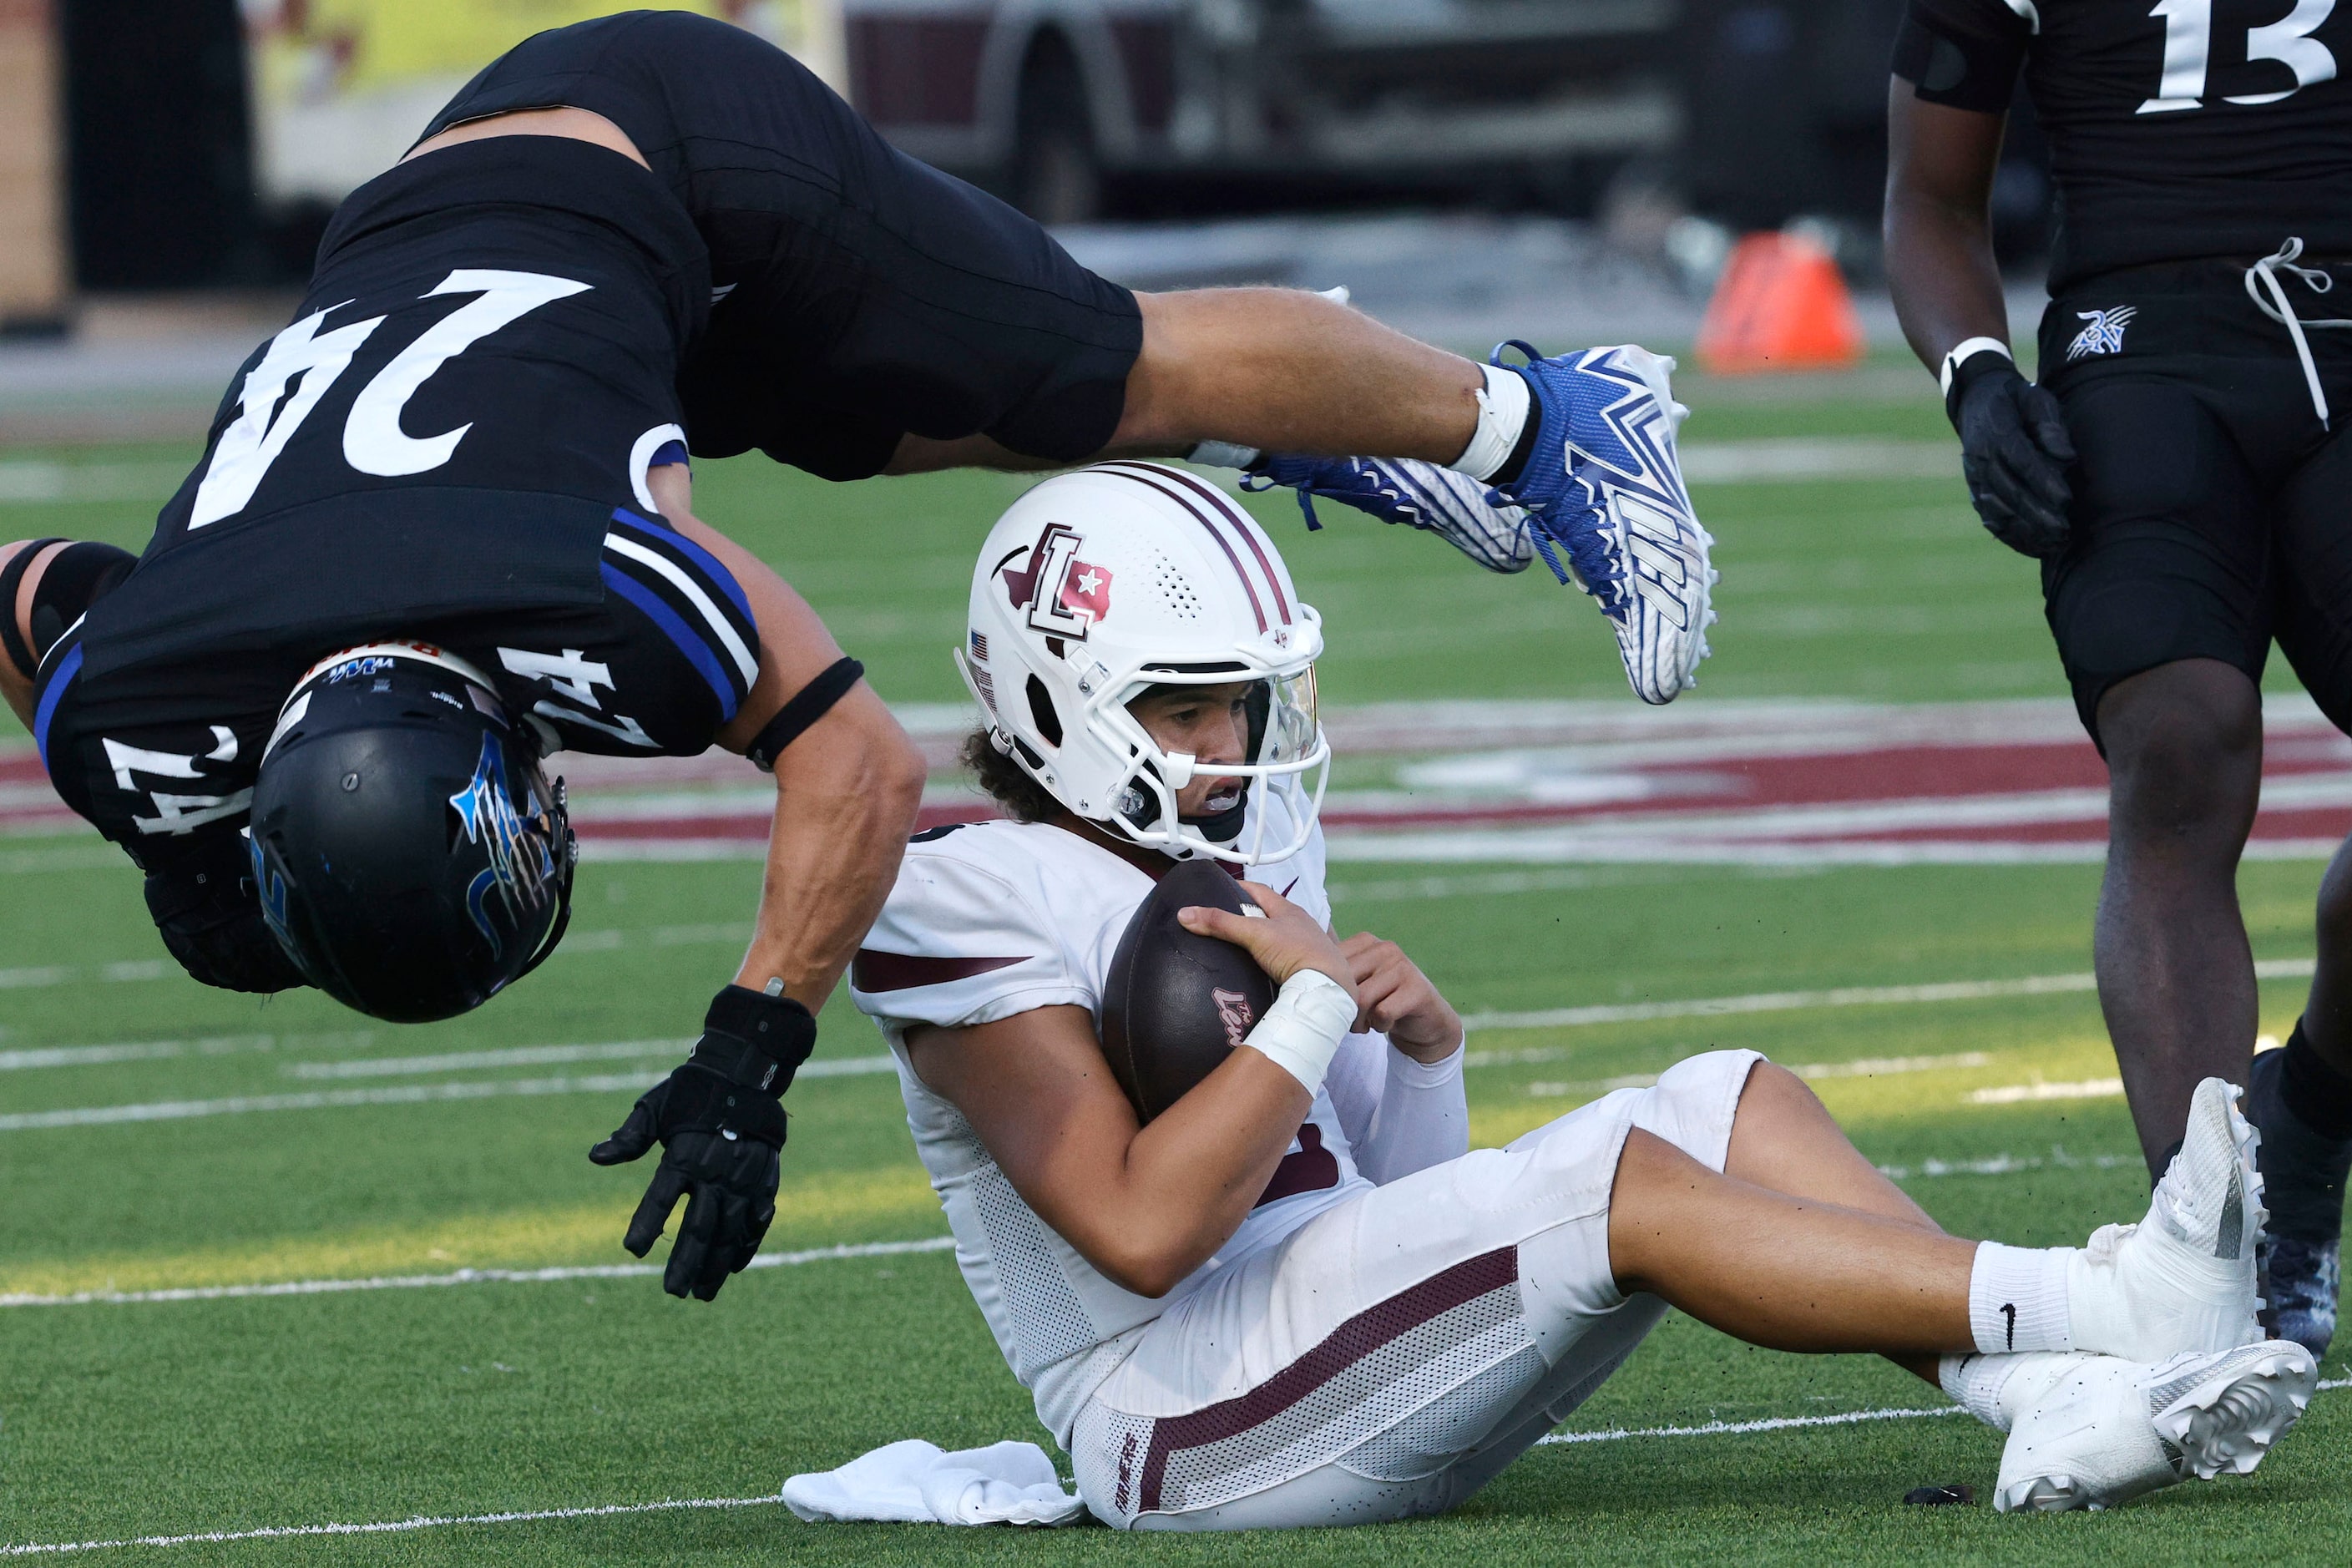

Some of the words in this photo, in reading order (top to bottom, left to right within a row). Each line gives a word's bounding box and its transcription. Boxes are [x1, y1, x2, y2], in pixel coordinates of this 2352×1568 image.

[2135, 0, 2337, 114] 13
[188, 269, 595, 531] 24
[496, 646, 664, 760] 24
[102, 725, 254, 836] 24
[1115, 1432, 1136, 1516] FARMERS
